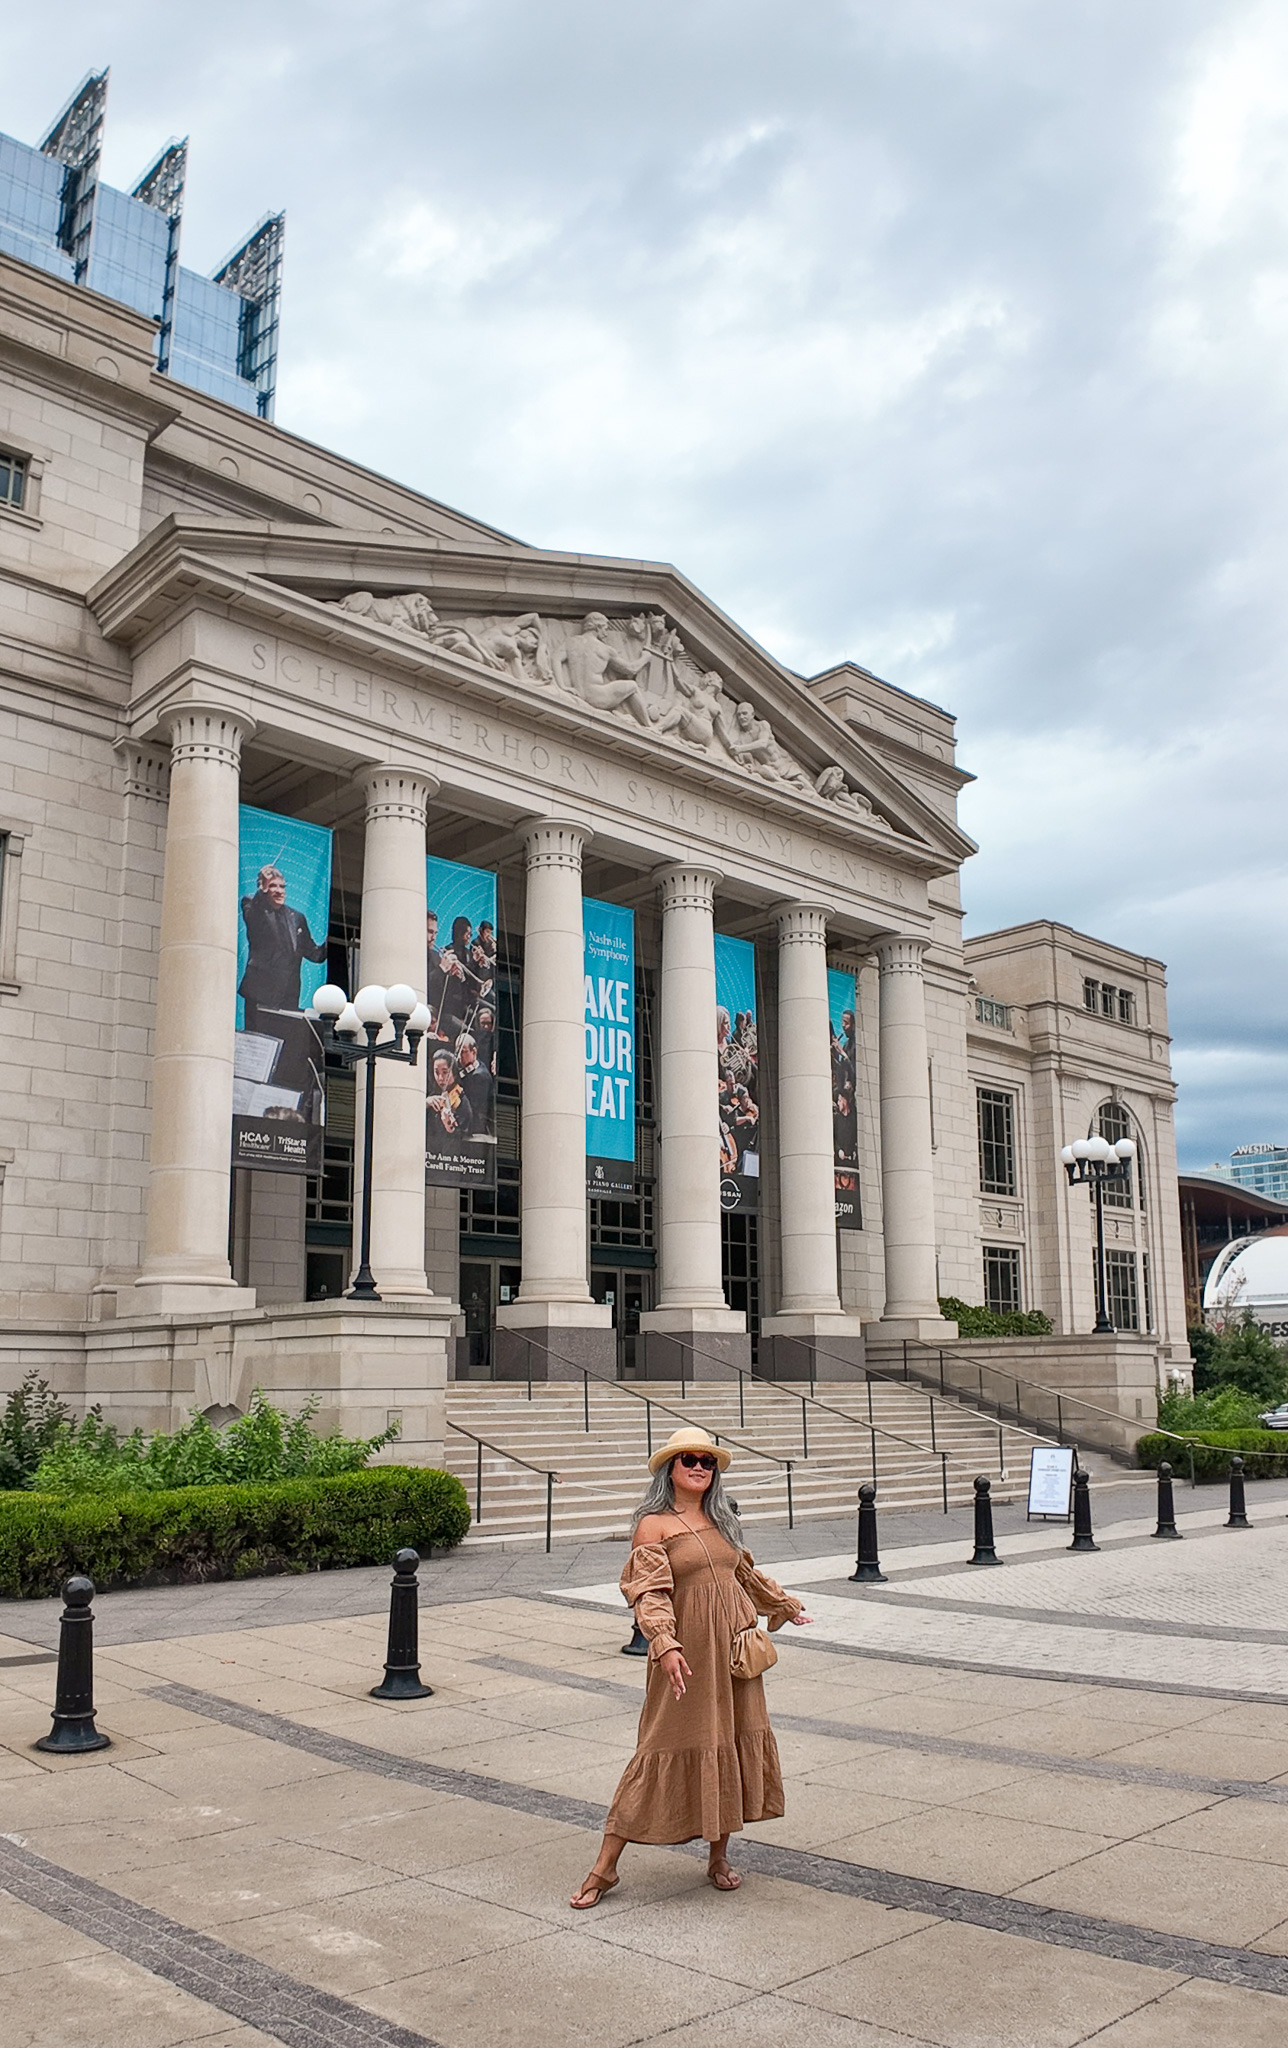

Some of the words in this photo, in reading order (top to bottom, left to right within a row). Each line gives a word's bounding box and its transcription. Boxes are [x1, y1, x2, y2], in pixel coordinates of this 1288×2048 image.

[251, 643, 600, 787] SCHERMERHORN
[627, 780, 791, 857] SYMPHONY
[809, 848, 906, 899] CENTER
[589, 931, 627, 950] Nashville
[588, 943, 630, 966] Symphony
[584, 974, 629, 1024] AKE
[584, 1023, 632, 1073] OUR
[586, 1072, 629, 1121] EAT
[240, 1131, 262, 1143] HCA
[278, 1136, 300, 1146] TriStar
[284, 1145, 306, 1154] Health
[1236, 1143, 1275, 1155] WESTIN
[425, 1151, 437, 1160] The
[437, 1153, 452, 1162] Ann
[452, 1155, 459, 1163] &
[459, 1156, 486, 1165] Monroe
[444, 1163, 467, 1175] Family
[467, 1166, 486, 1174] Trust
[722, 1190, 742, 1198] SSAN
[835, 1202, 853, 1213] azon
